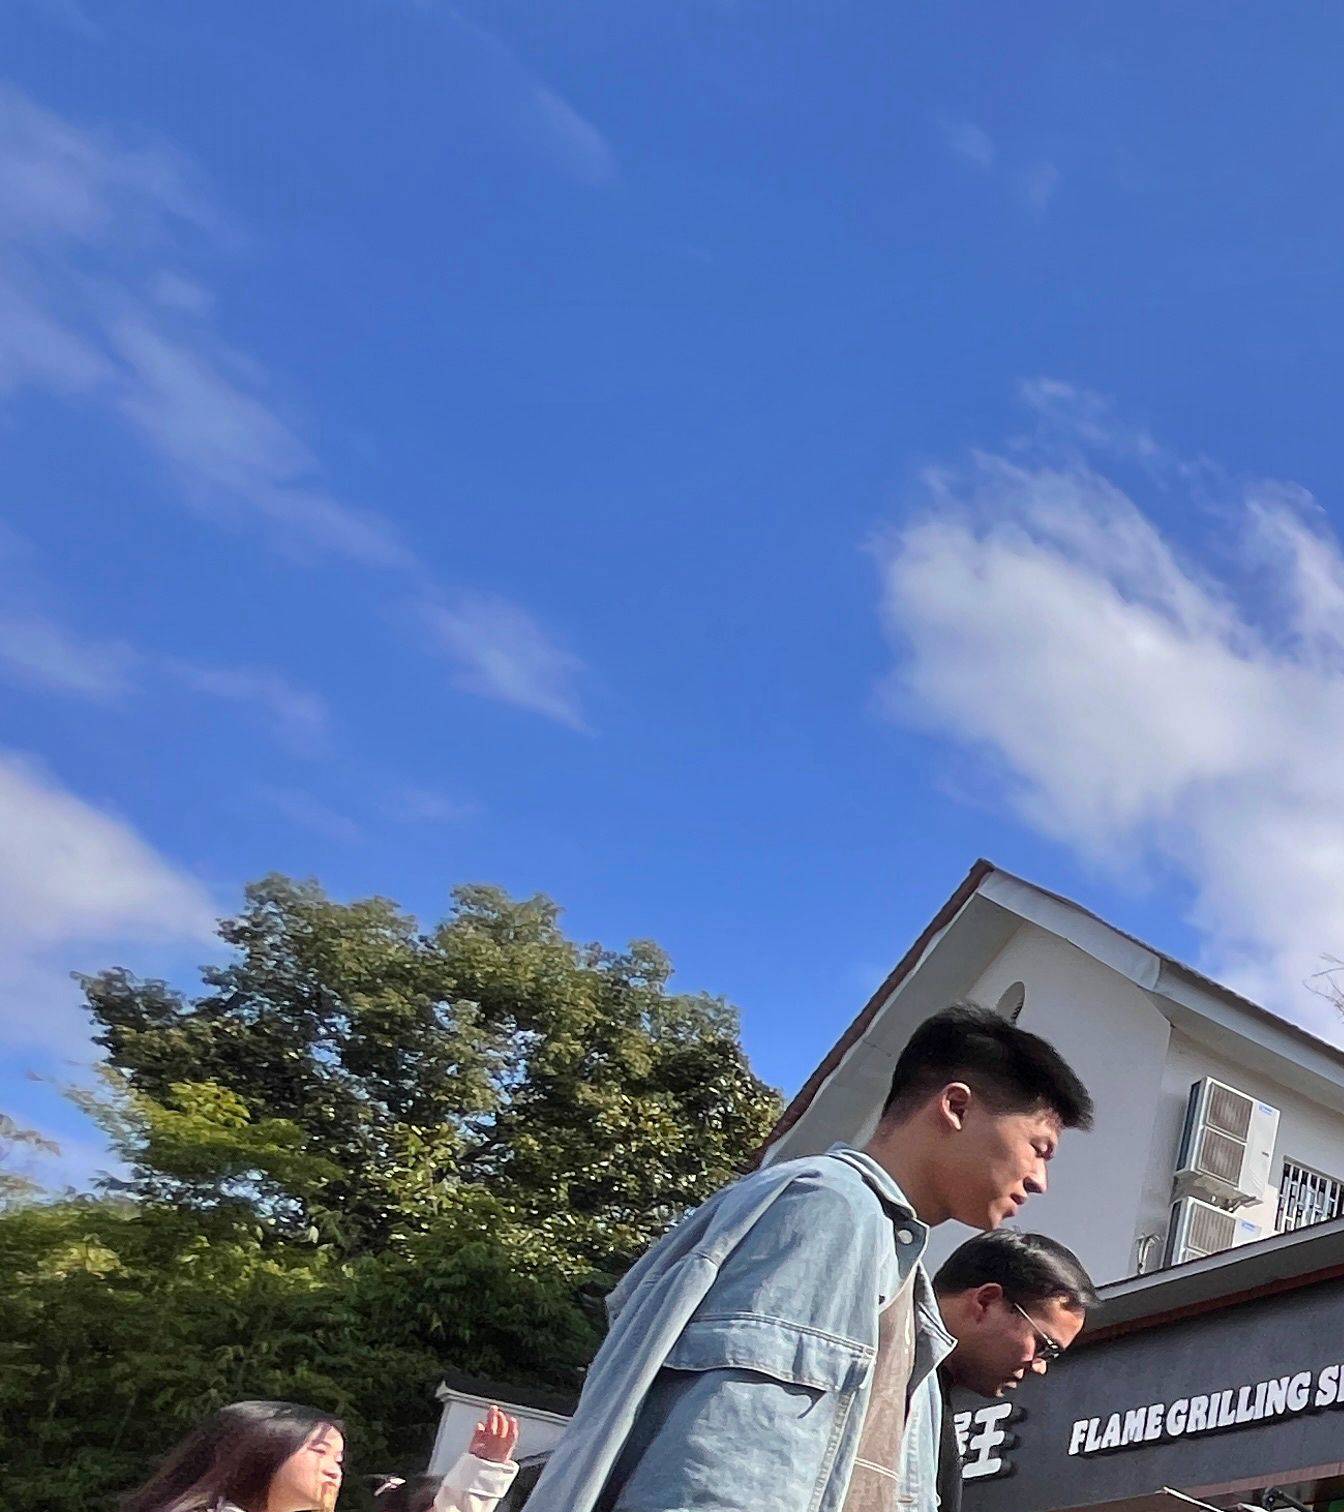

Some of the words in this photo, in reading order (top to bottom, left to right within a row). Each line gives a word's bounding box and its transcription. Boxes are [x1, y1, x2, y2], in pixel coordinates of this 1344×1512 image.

[953, 1402, 1013, 1479] 王
[1067, 1402, 1164, 1455] FLAME
[1166, 1370, 1311, 1438] GRILLING
